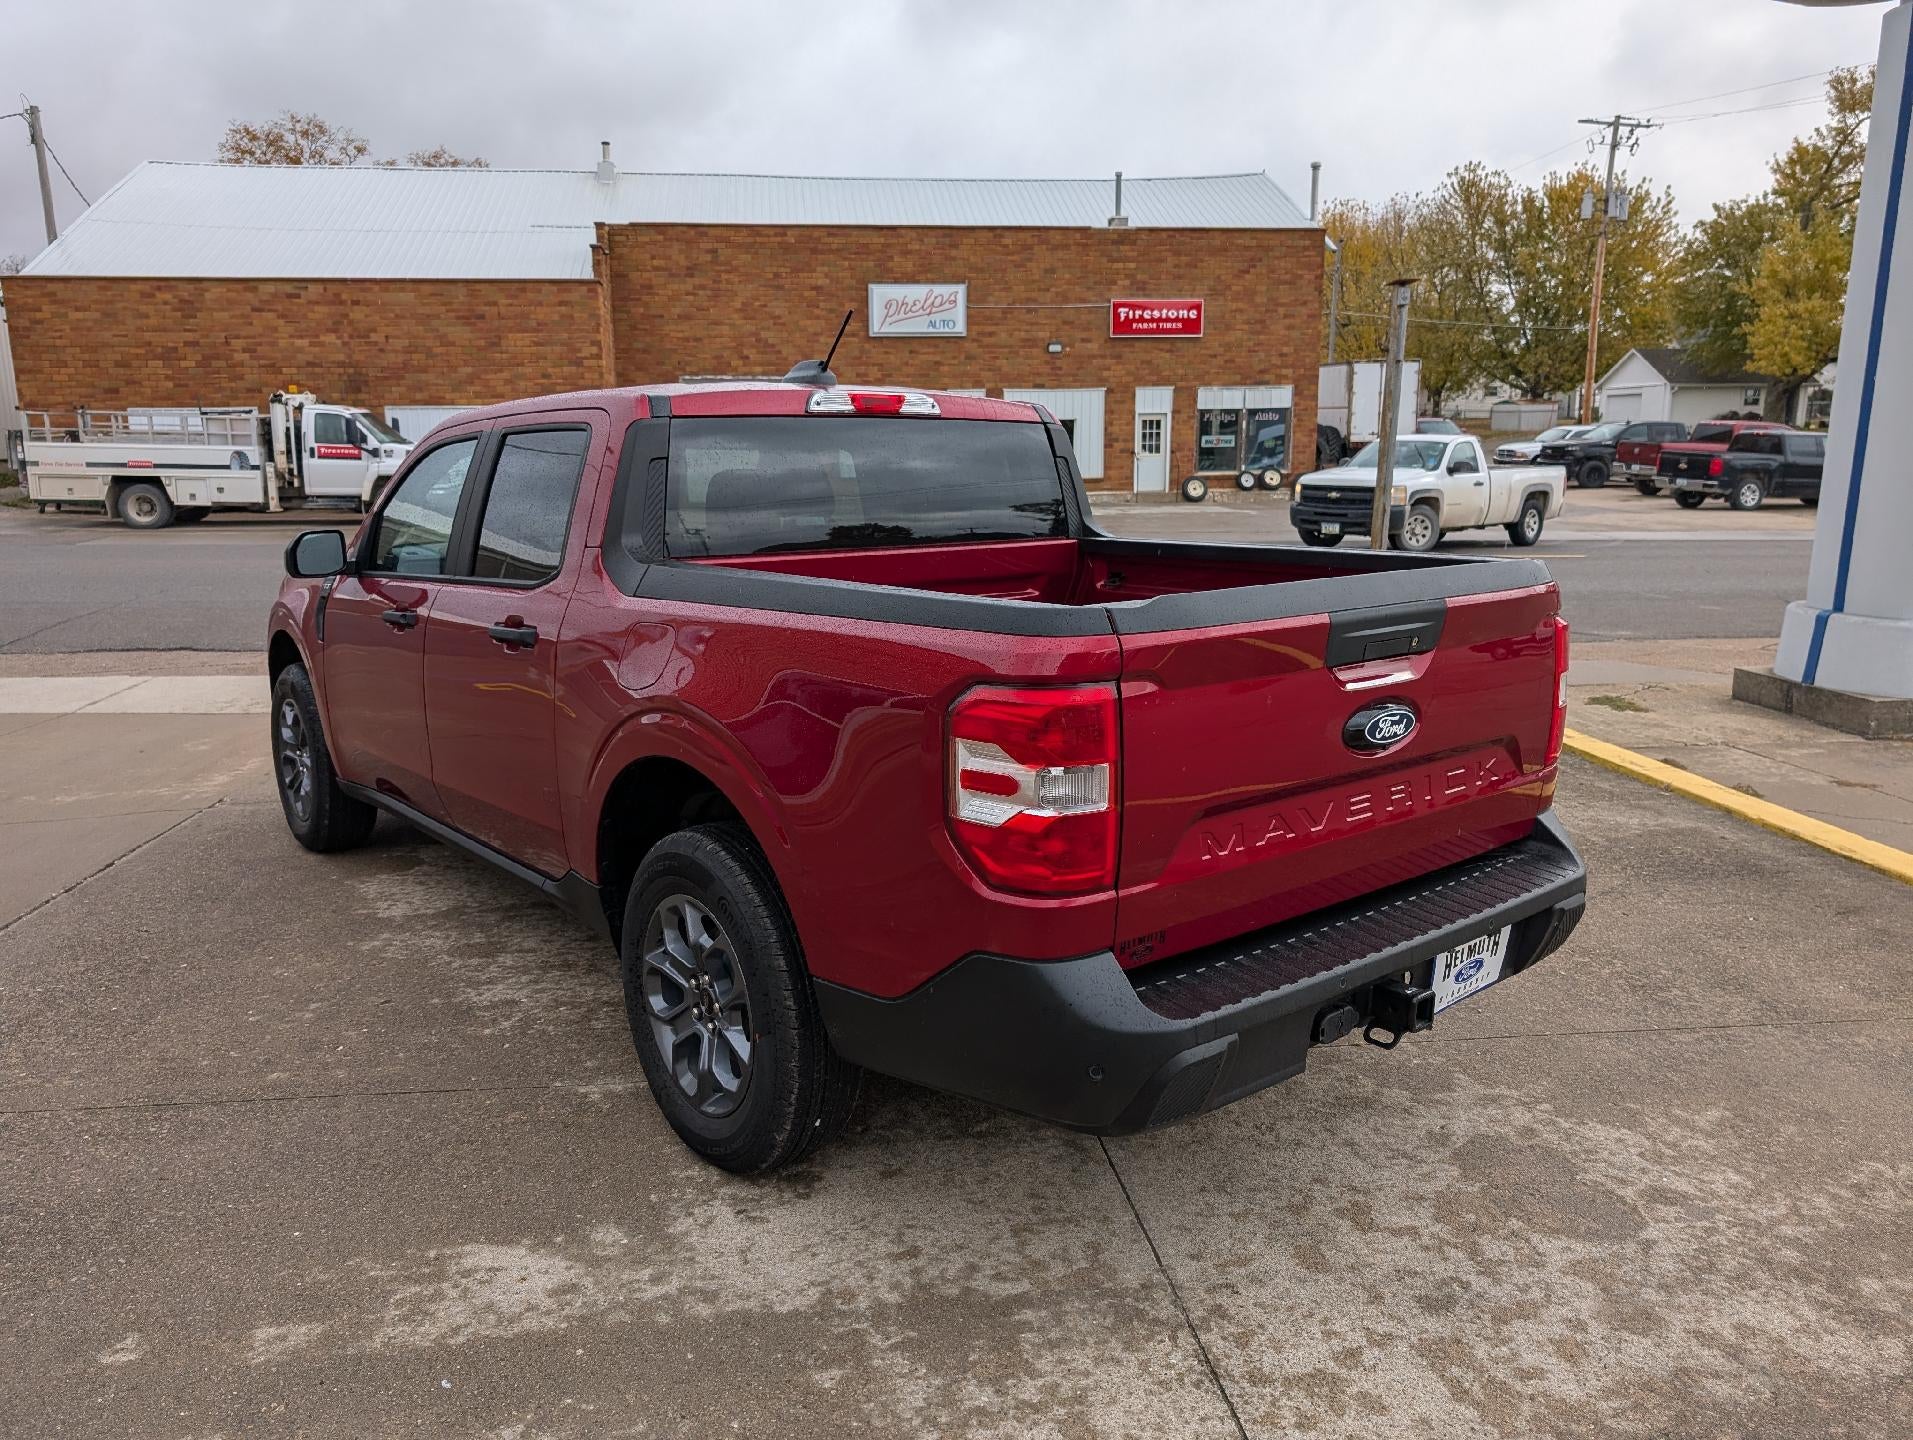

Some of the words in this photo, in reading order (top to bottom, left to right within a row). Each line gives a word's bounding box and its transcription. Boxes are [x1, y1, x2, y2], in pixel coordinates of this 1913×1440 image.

[879, 288, 959, 331] Phelps
[1118, 307, 1198, 322] Firestone
[927, 319, 956, 330] AUTO
[320, 447, 360, 456] Firestone
[1375, 715, 1407, 739] Ford
[1202, 757, 1500, 861] MAVERICK
[1442, 933, 1500, 982] HELMUTH
